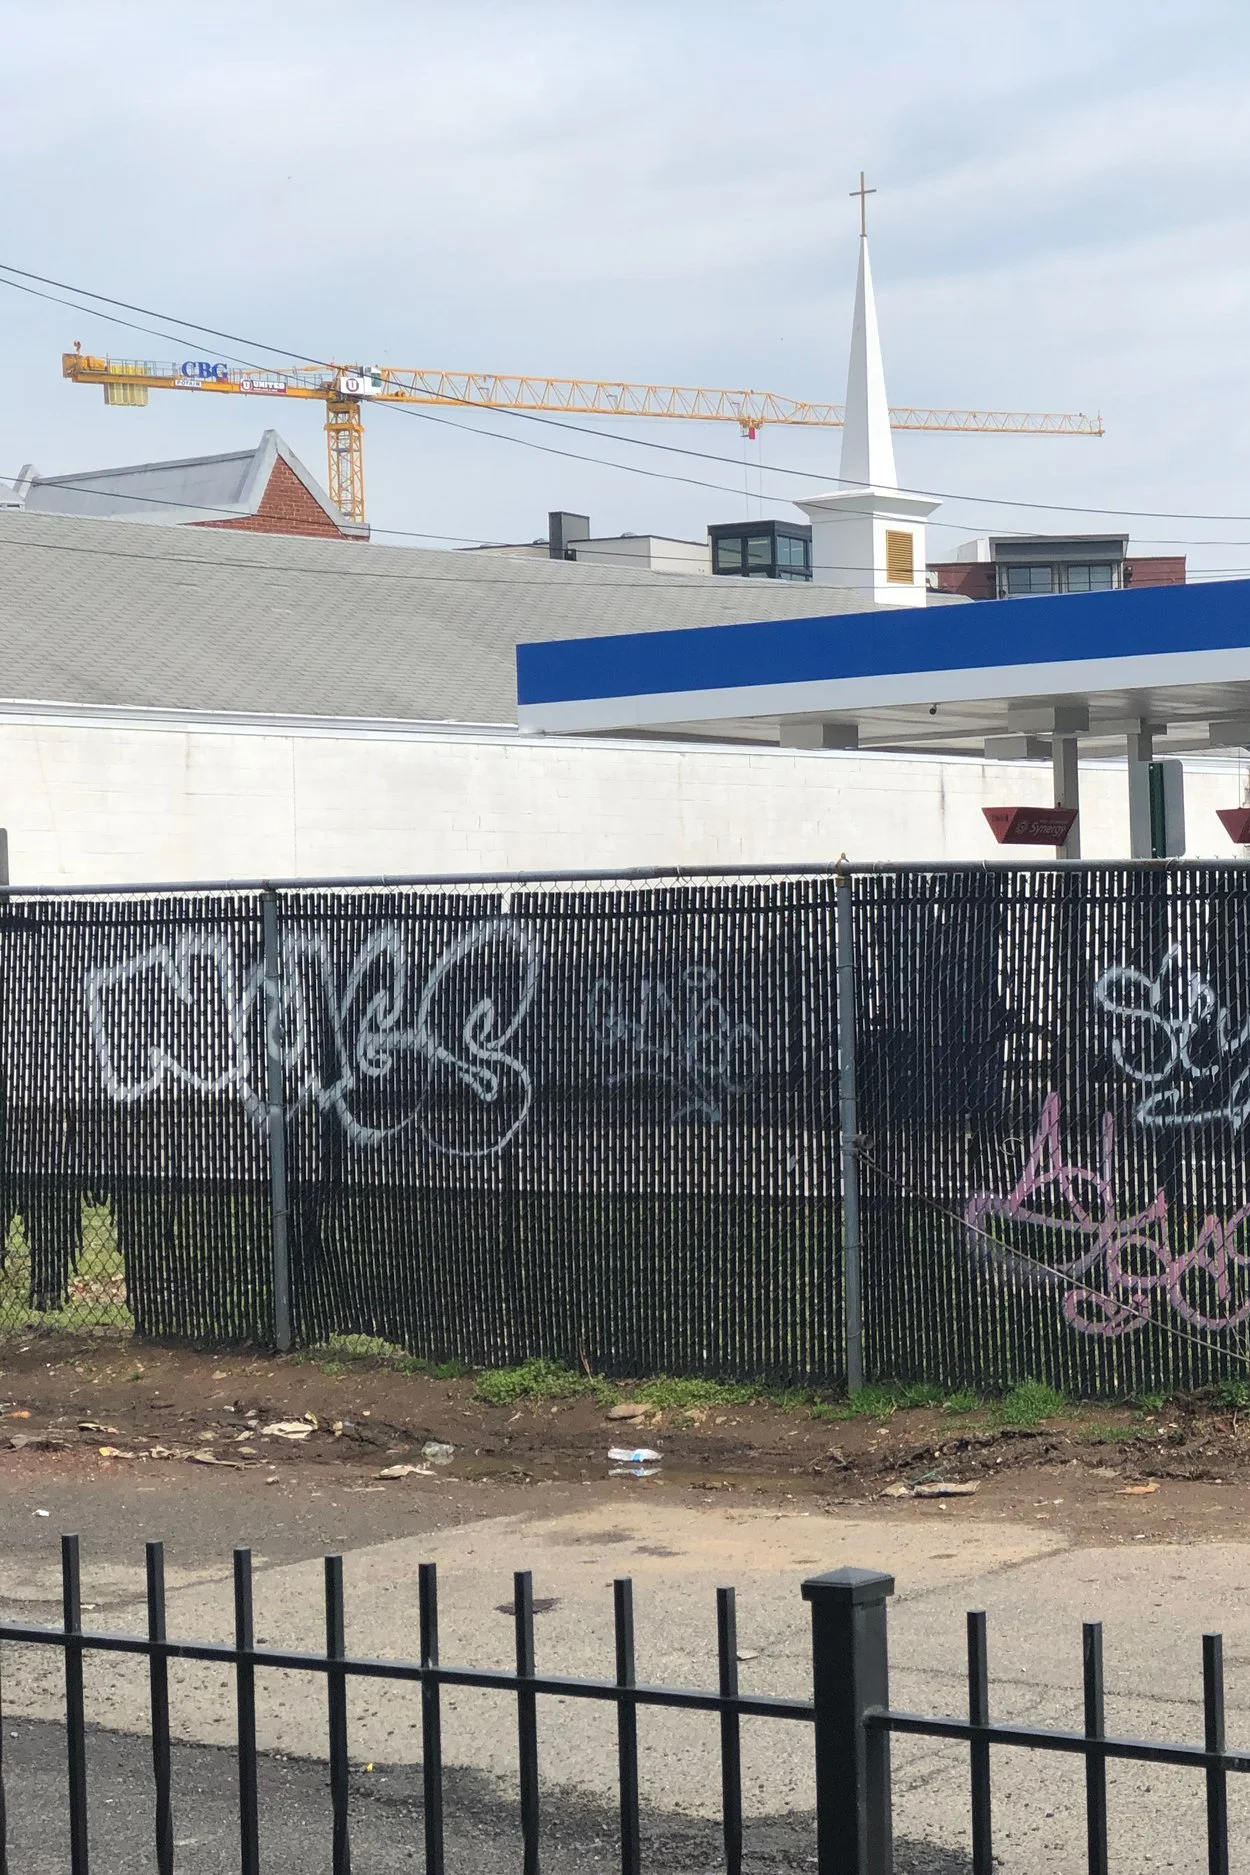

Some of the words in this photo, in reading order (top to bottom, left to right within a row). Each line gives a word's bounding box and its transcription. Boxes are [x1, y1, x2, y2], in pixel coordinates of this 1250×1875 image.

[182, 361, 228, 379] CBG
[253, 381, 285, 390] UNITED
[1029, 821, 1067, 836] Synergy
